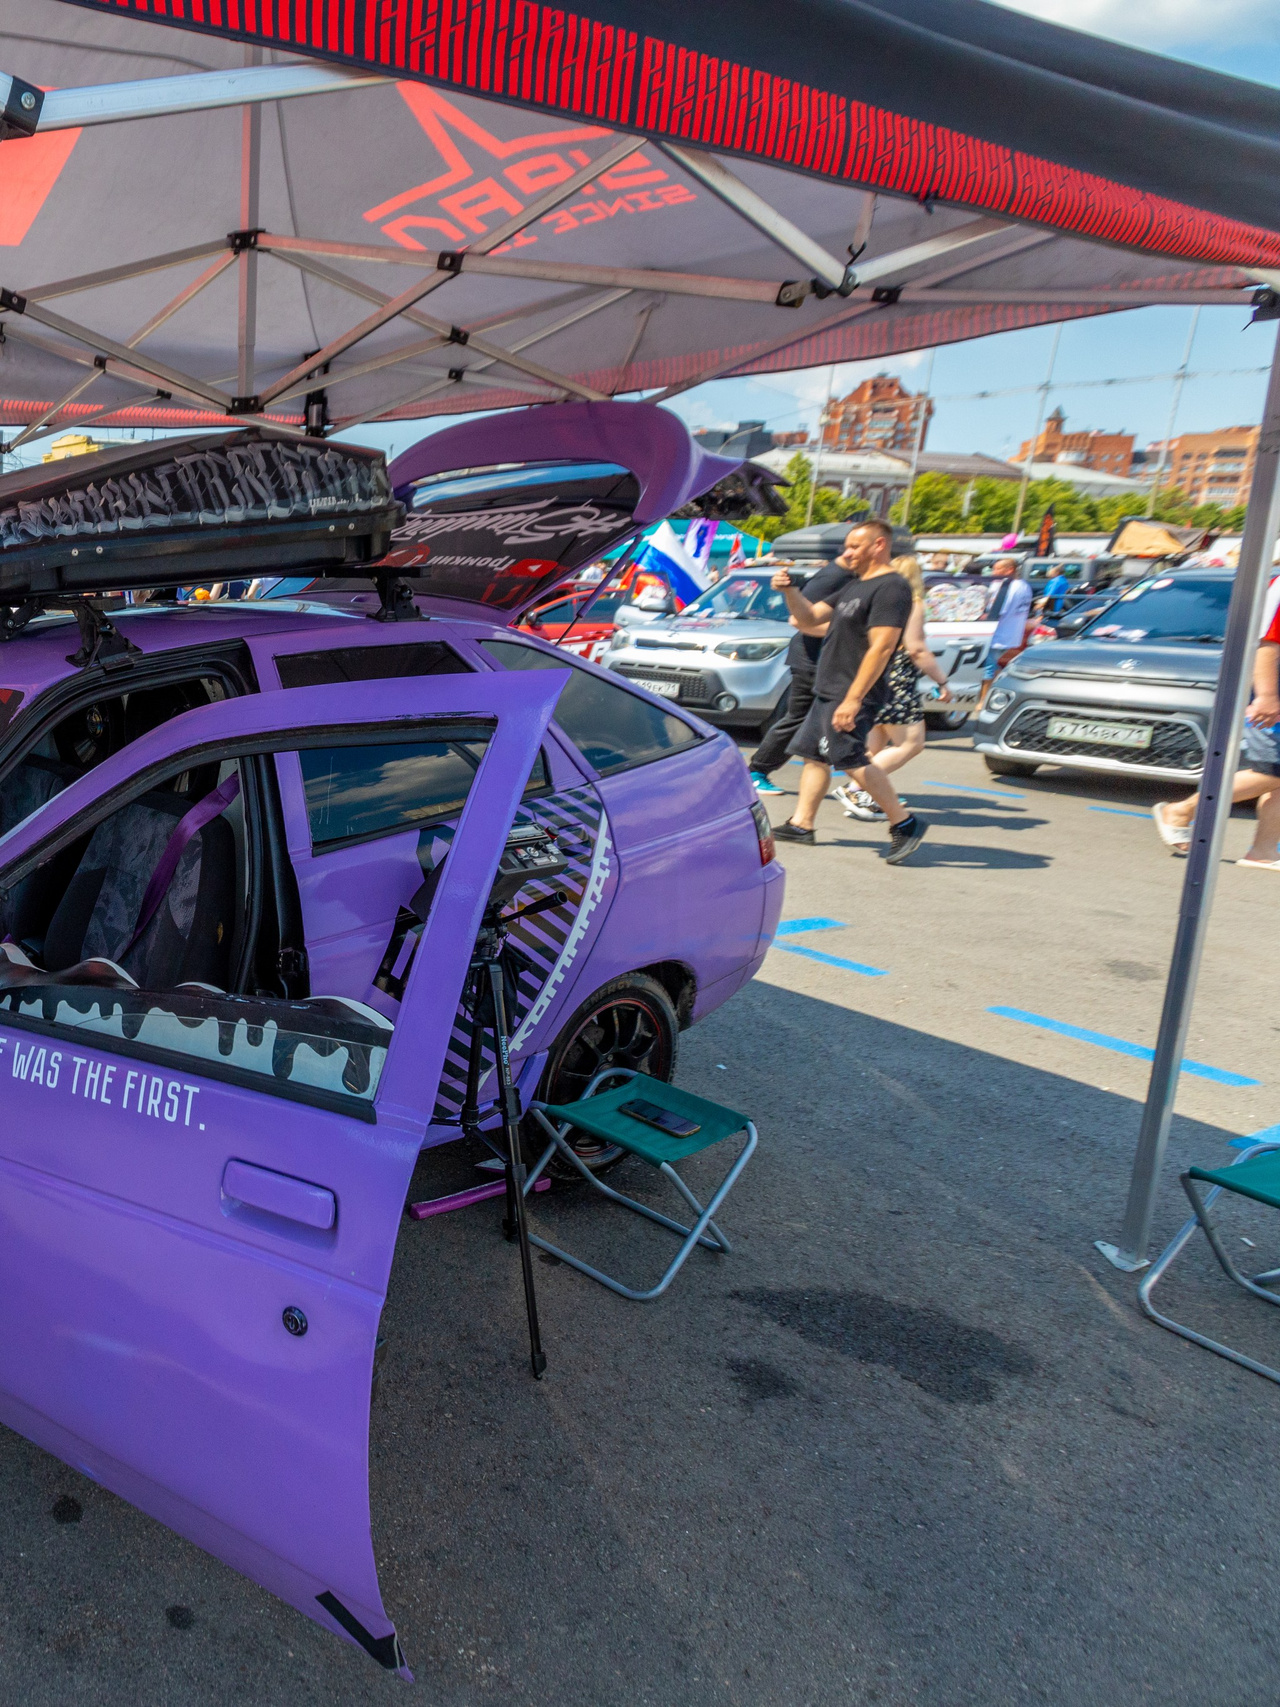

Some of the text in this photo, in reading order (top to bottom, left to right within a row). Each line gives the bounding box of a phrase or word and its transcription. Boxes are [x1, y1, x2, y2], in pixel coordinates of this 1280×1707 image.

[12, 1041, 62, 1089] WAS
[71, 1056, 117, 1105] THE
[122, 1070, 206, 1131] FIRST.
